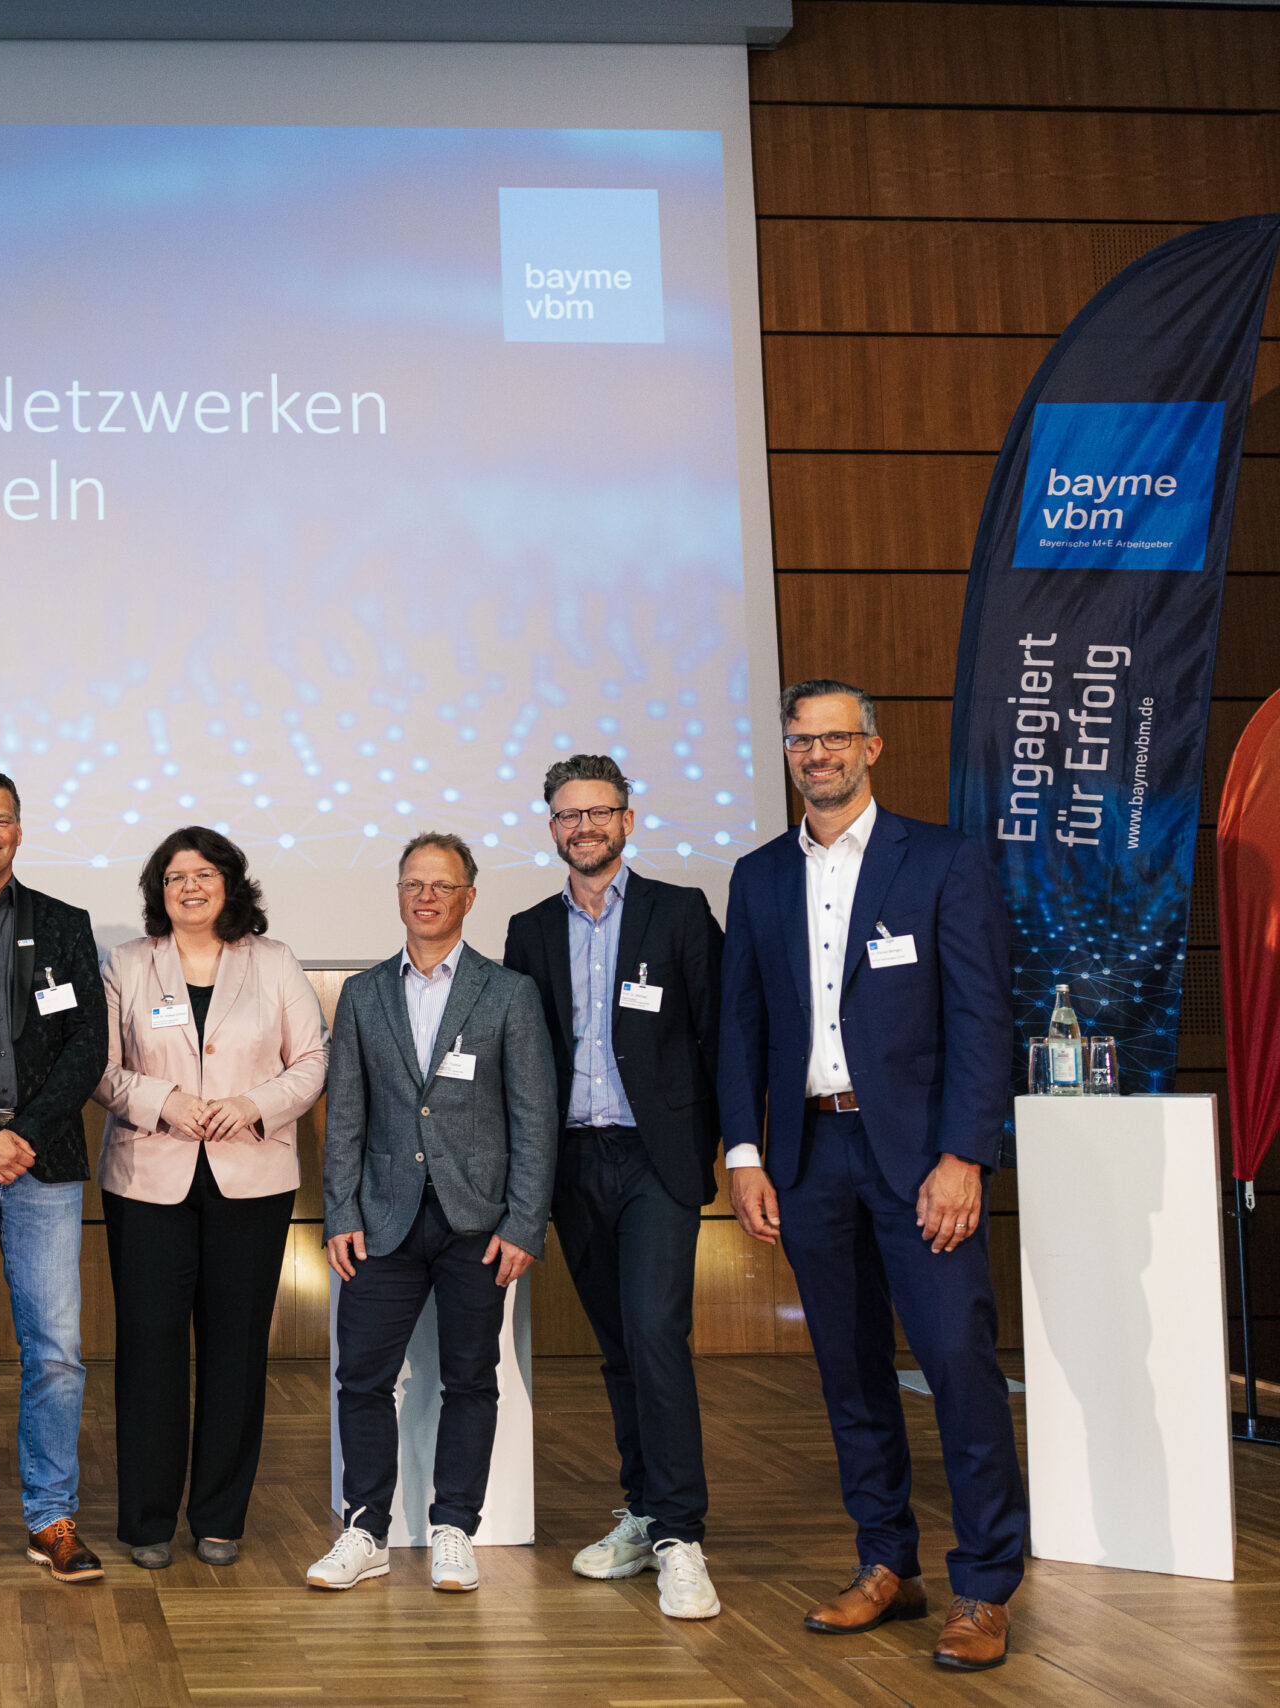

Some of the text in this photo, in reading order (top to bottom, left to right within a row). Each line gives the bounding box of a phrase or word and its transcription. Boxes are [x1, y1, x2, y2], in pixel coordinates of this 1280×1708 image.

[525, 262, 632, 295] bayme
[525, 293, 594, 320] vbm
[1047, 467, 1177, 504] bayme
[1042, 501, 1123, 530] vbm
[1039, 538, 1173, 550] Bayerische M+E Arbeitgeber
[997, 632, 1058, 842] Engagiert
[1055, 644, 1132, 847] für Erfolg
[1127, 696, 1154, 850] www.baymevbm.de
